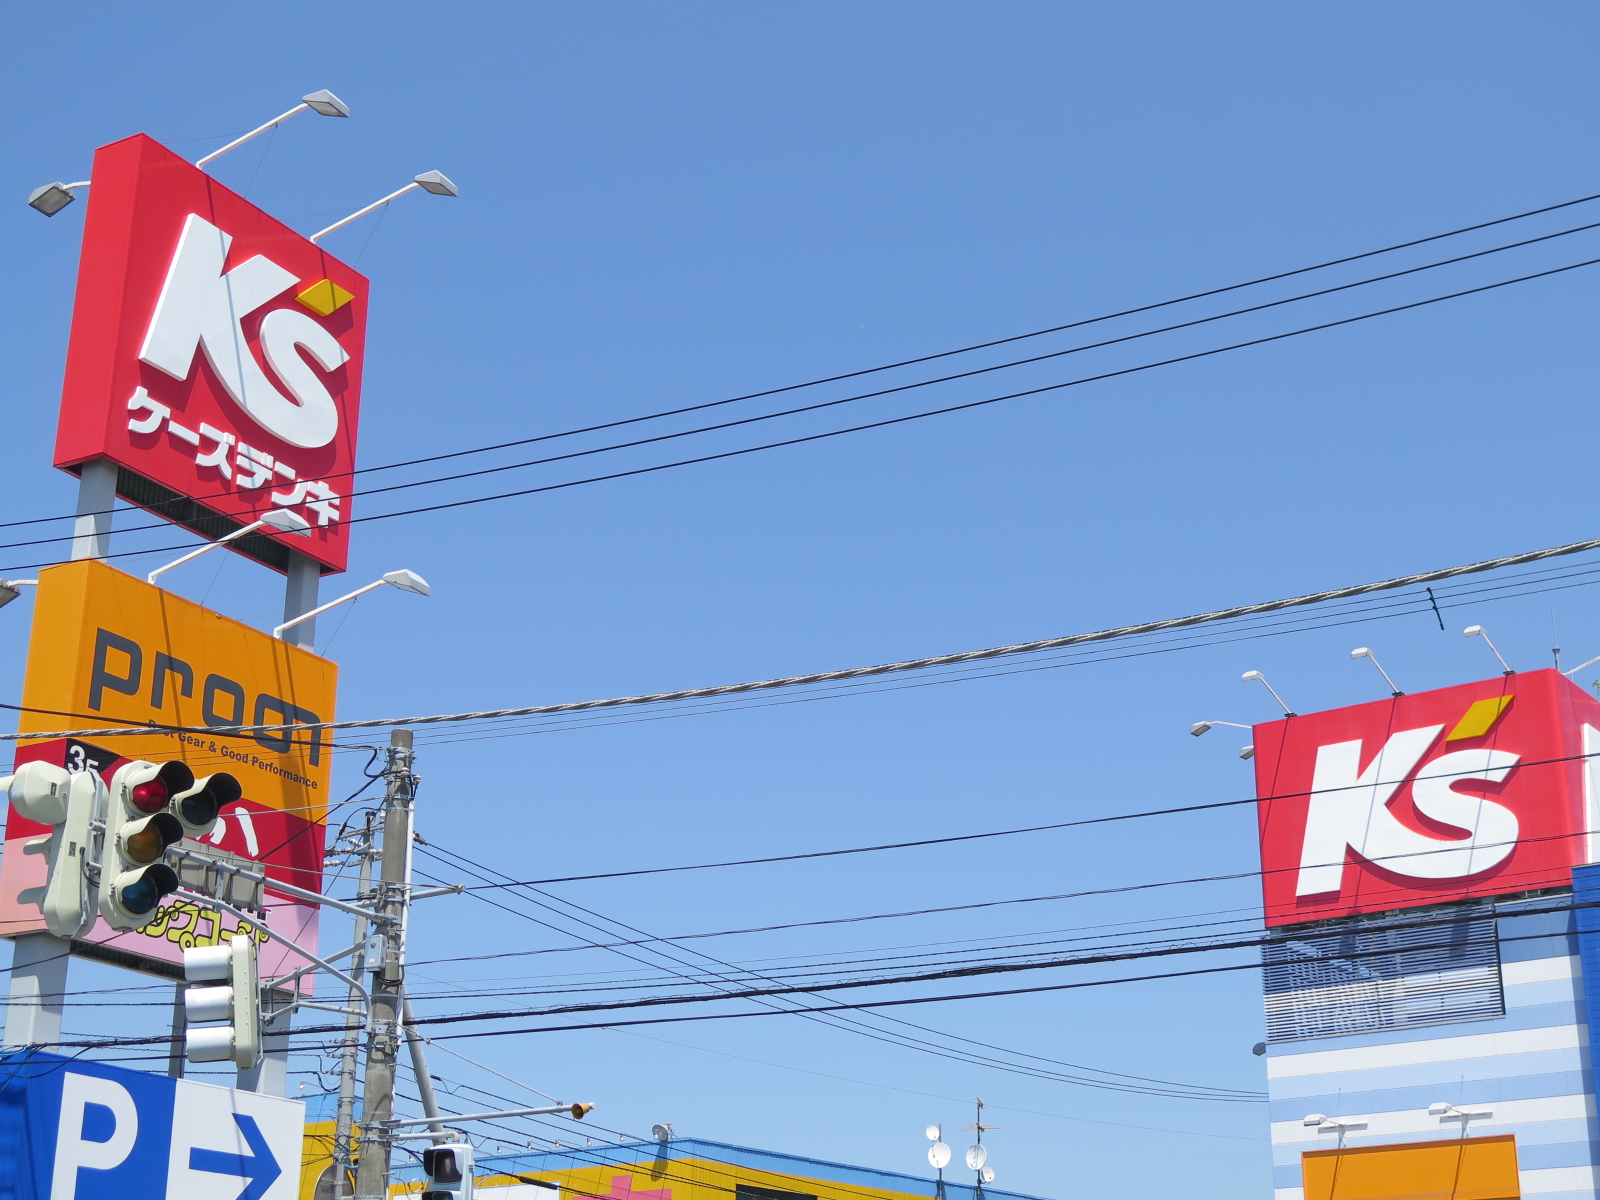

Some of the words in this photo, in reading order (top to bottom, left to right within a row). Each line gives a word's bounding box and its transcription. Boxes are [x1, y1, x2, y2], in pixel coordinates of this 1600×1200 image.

[128, 386, 340, 528] ケーズデンキ
[178, 730, 206, 749] Gear
[208, 741, 217, 753] &
[220, 745, 249, 764] Good
[251, 755, 318, 790] Performance
[50, 1071, 138, 1200] P
